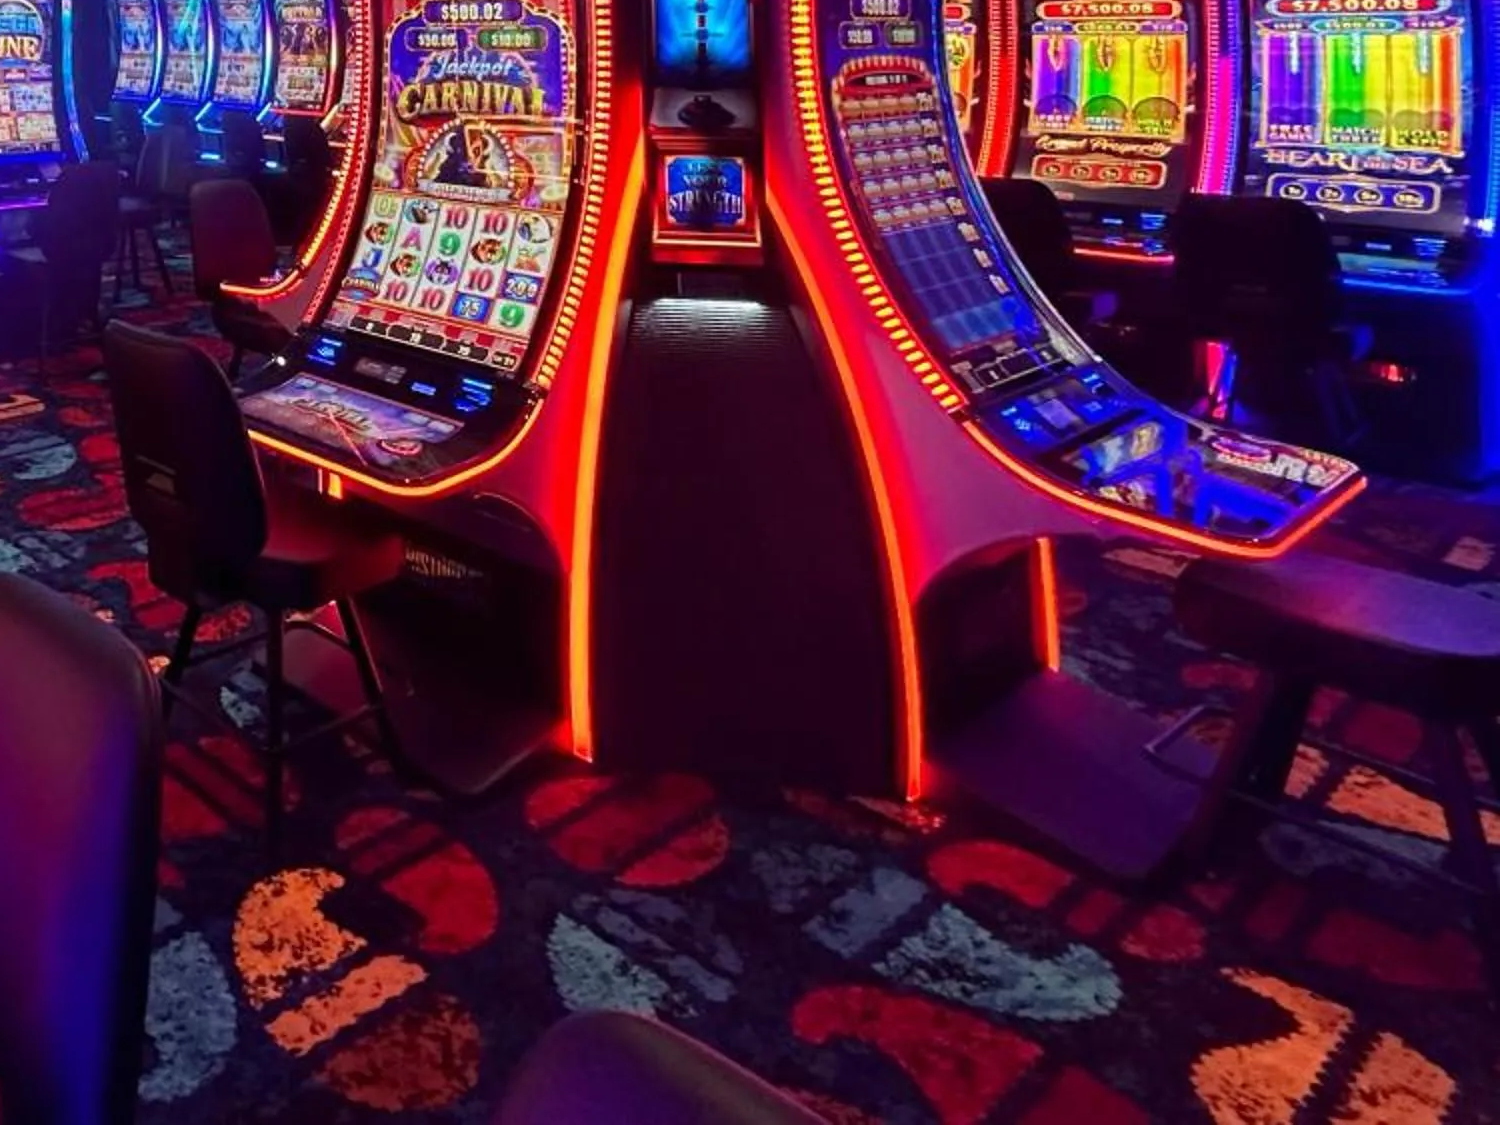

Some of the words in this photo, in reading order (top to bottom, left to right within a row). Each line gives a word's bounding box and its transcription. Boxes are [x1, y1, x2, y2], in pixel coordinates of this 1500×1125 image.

[430, 54, 513, 80] Jackpot
[398, 80, 548, 118] CARNIVAL
[1394, 156, 1454, 175] SEA
[444, 206, 469, 230] 10
[482, 211, 509, 236] 10
[401, 226, 423, 251] A
[439, 231, 461, 256] 9
[361, 249, 383, 268] J
[385, 280, 408, 302] 10
[467, 268, 494, 292] 10
[419, 288, 446, 311] 10
[498, 300, 525, 326] 9
